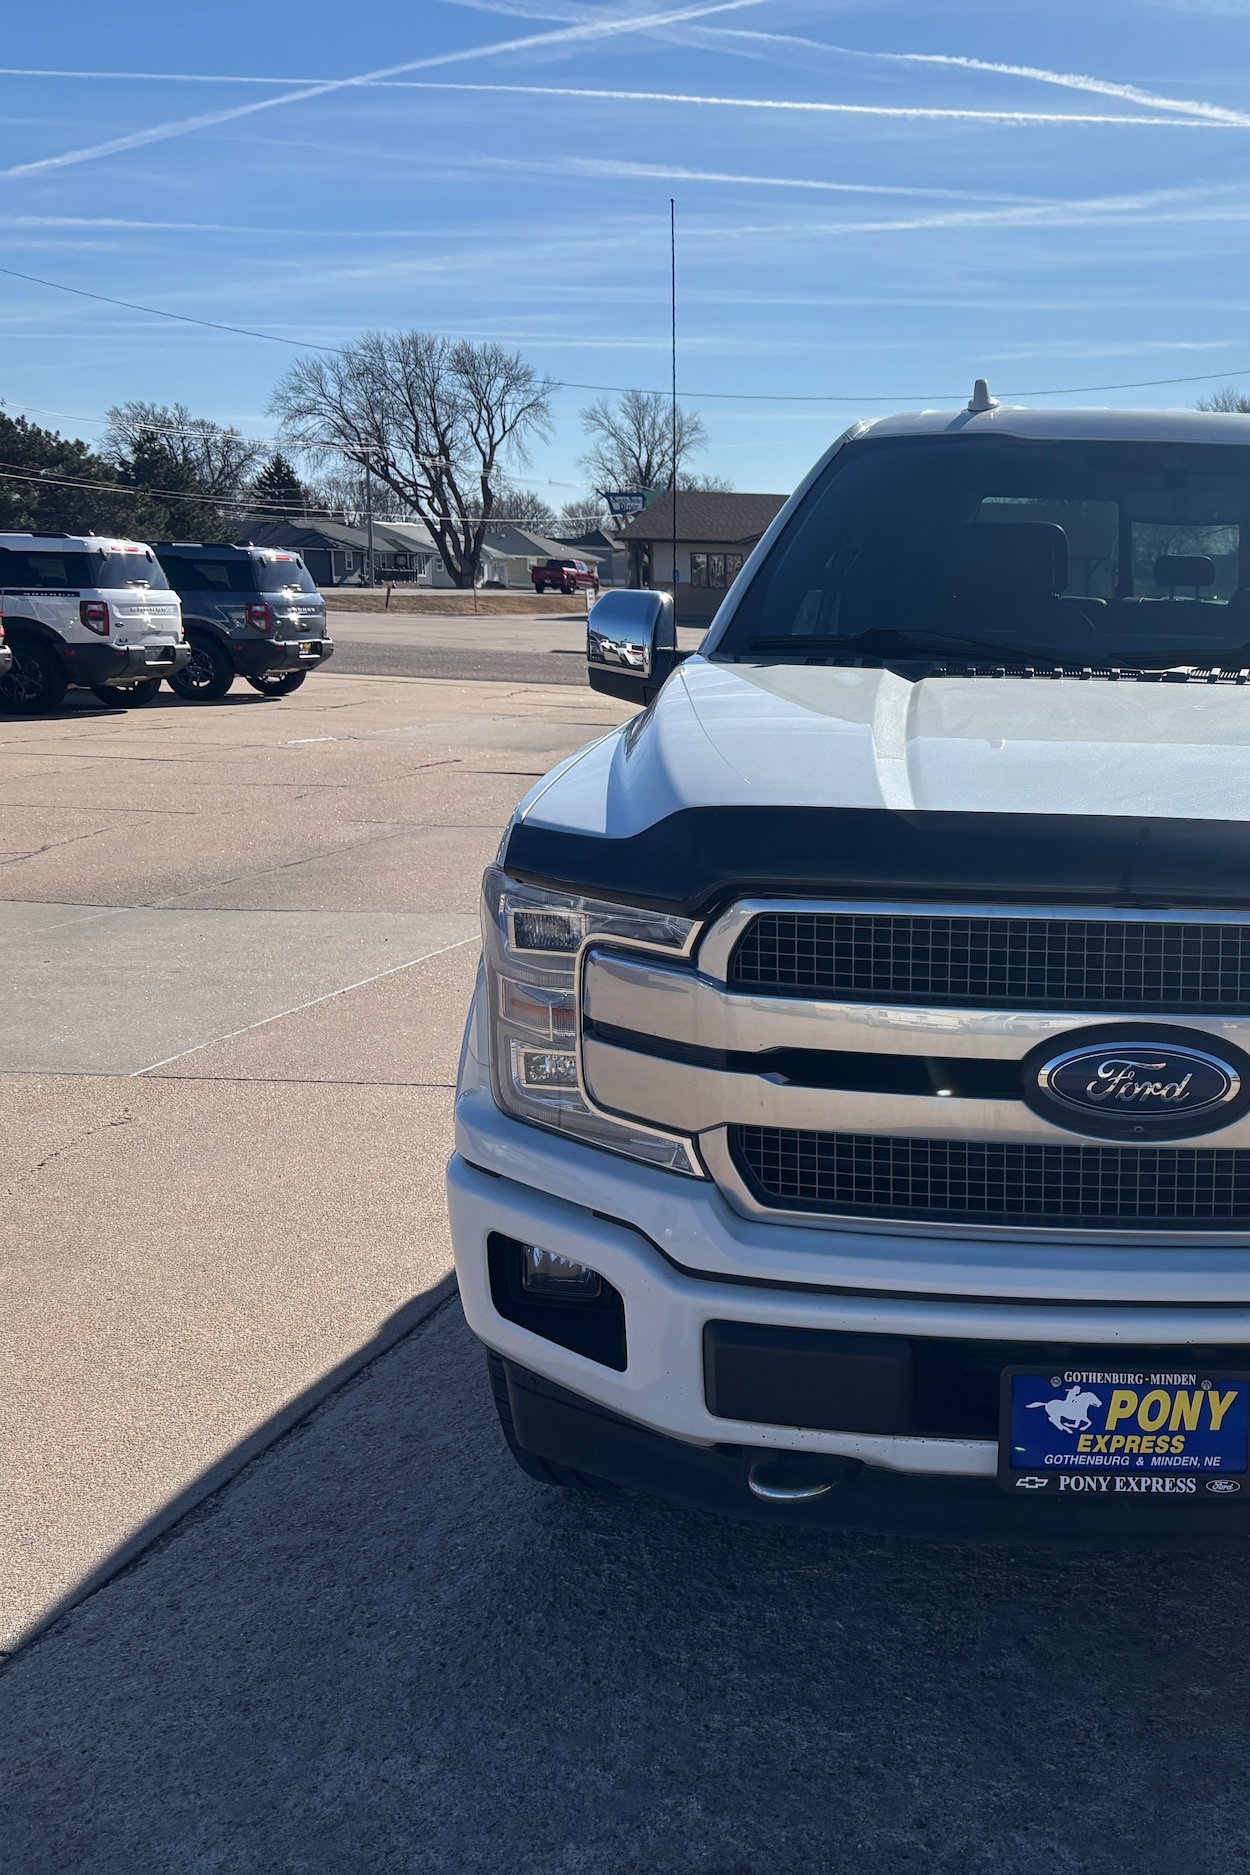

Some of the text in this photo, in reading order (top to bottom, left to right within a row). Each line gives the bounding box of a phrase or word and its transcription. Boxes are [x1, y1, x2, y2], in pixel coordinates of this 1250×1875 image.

[1085, 1058, 1193, 1103] Ford
[1064, 1371, 1197, 1386] GOTHENBURG-MINDEN
[1104, 1389, 1239, 1432] PONY
[1077, 1434, 1186, 1454] EXPRESS
[1044, 1454, 1221, 1468] GOTHENBURG & MINDEN, NE
[1058, 1475, 1197, 1493] PONY EXPRESS
[1212, 1481, 1234, 1491] Ford
